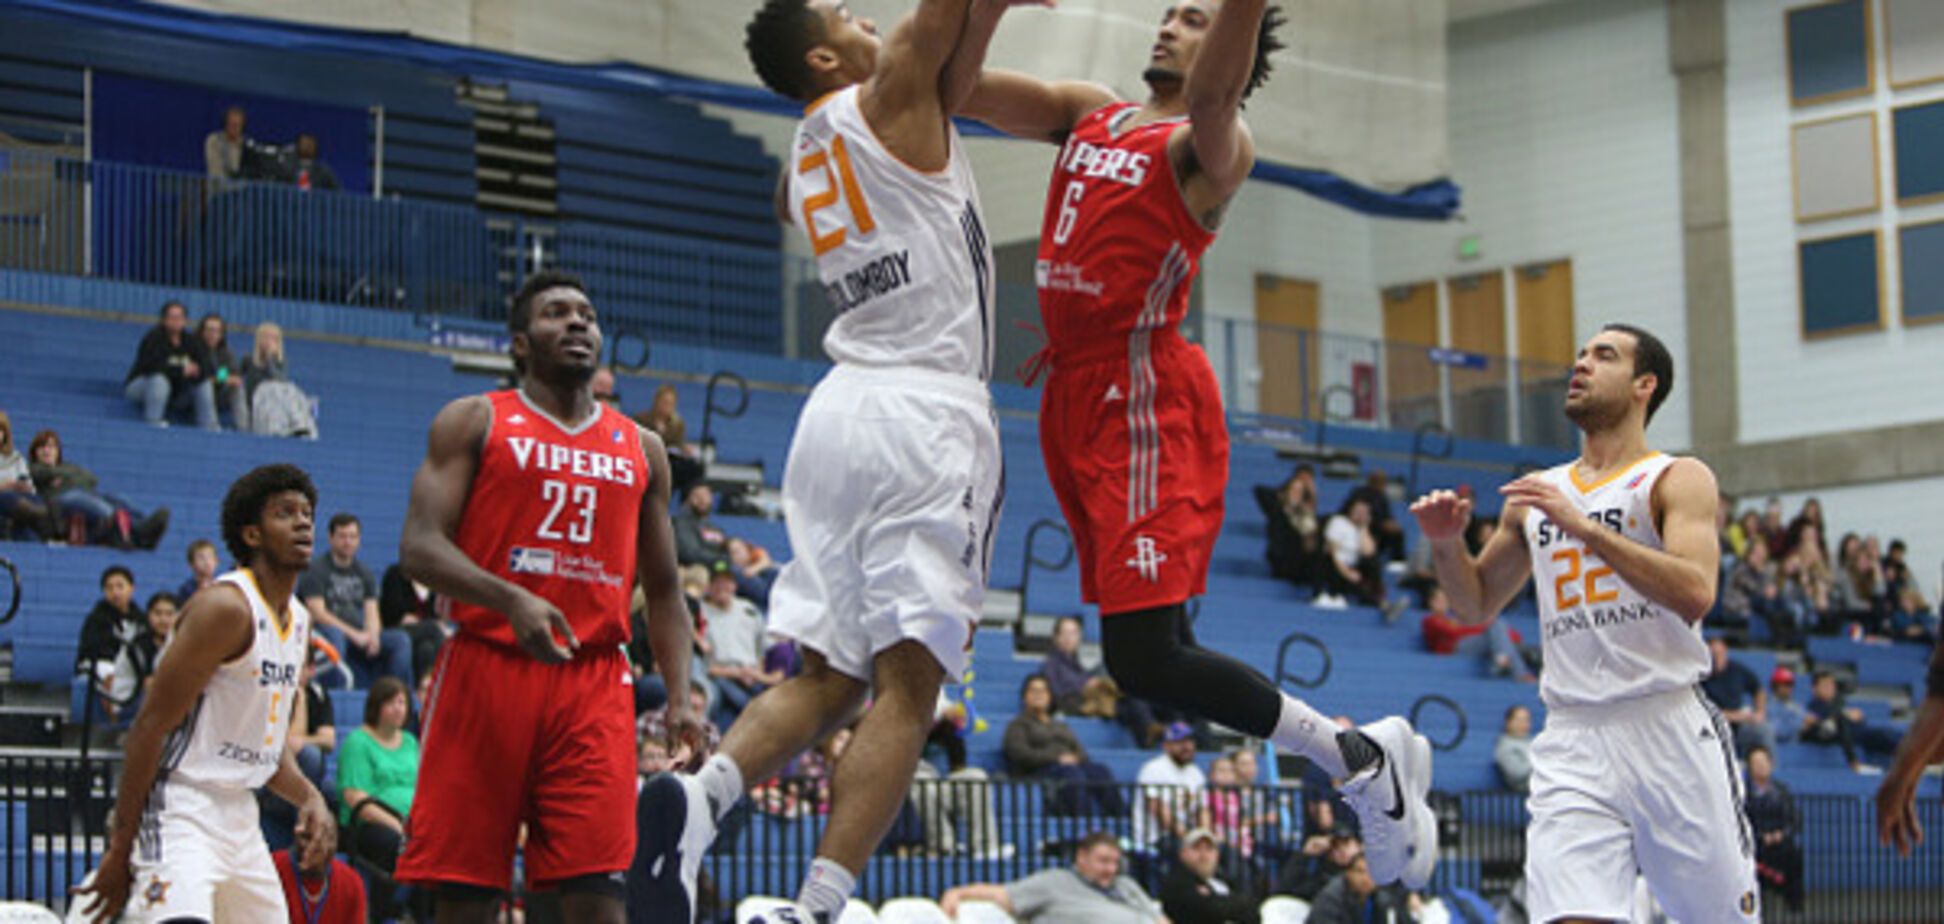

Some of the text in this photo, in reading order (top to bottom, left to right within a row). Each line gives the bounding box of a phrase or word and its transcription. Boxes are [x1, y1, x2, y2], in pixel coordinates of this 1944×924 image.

[798, 131, 876, 256] 21
[1053, 180, 1085, 244] 6
[507, 437, 635, 487] VIPERS
[537, 479, 597, 543] 23
[1551, 548, 1619, 612] 22
